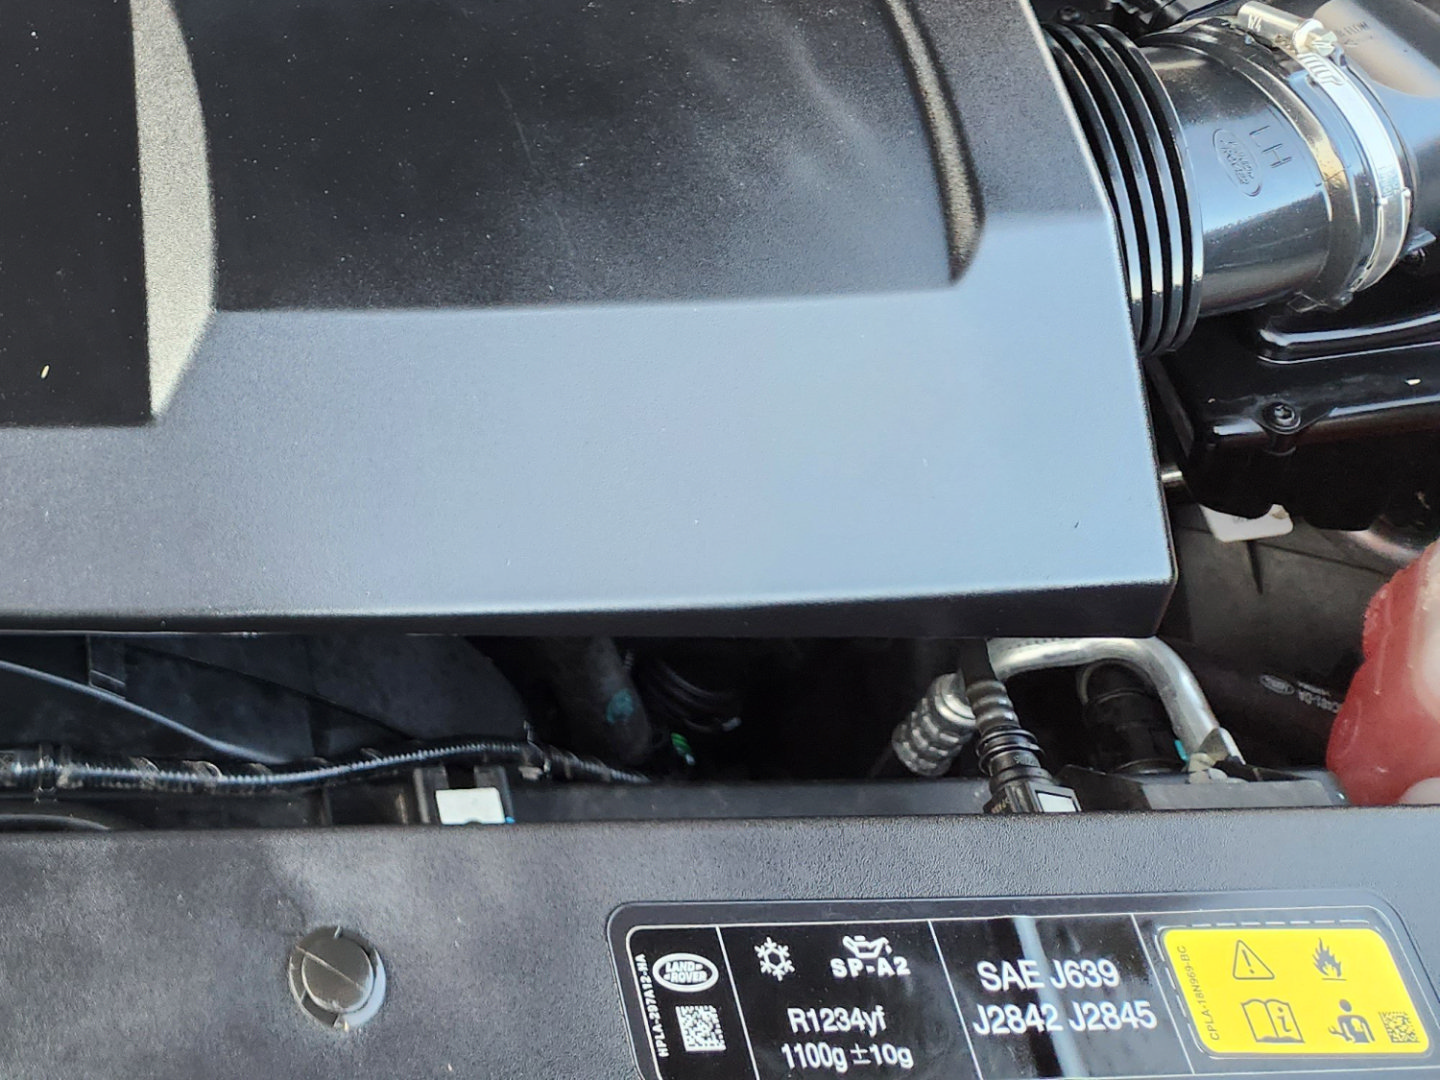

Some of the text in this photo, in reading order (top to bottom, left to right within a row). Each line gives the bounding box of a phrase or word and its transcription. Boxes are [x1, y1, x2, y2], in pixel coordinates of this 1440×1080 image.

[666, 960, 696, 972] LAND
[670, 970, 708, 984] ROVER
[830, 956, 911, 979] SP-A2
[976, 957, 1121, 992] SAE J639
[786, 1004, 887, 1038] R1234yf
[972, 999, 1158, 1035] J2842 J2845
[781, 1041, 848, 1073] 1100g
